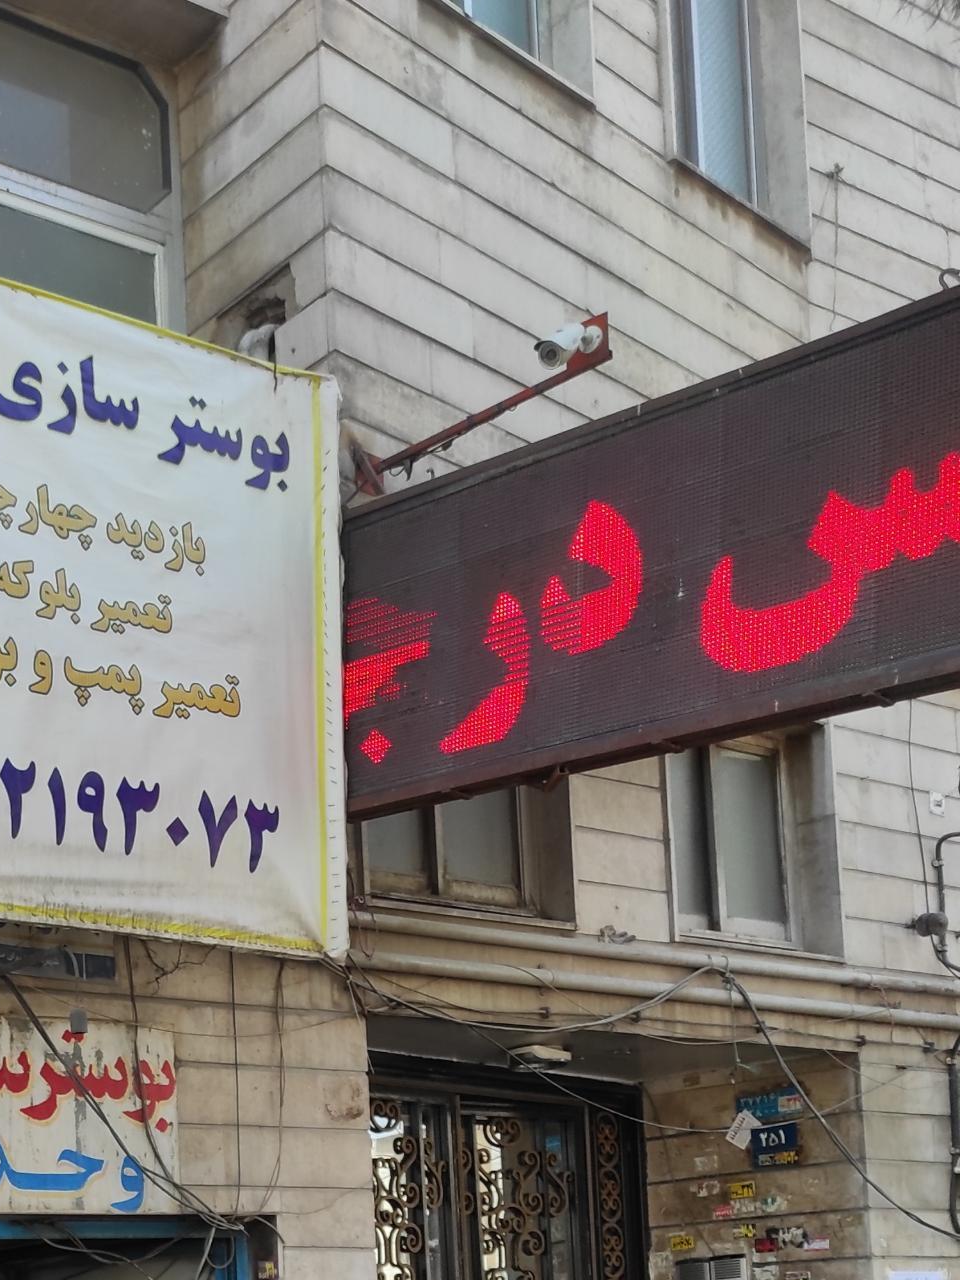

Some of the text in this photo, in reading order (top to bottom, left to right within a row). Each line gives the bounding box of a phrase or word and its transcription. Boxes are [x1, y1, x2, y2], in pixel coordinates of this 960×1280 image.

[157, 394, 291, 492] بوستر
[17, 484, 98, 551] چهار
[106, 512, 207, 577] بازدید
[90, 594, 174, 635] تعمیر
[28, 647, 54, 696] و
[62, 655, 145, 716] پمپ
[151, 673, 242, 720] تعمیر
[759, 1128, 786, 1148] ۲۵۱
